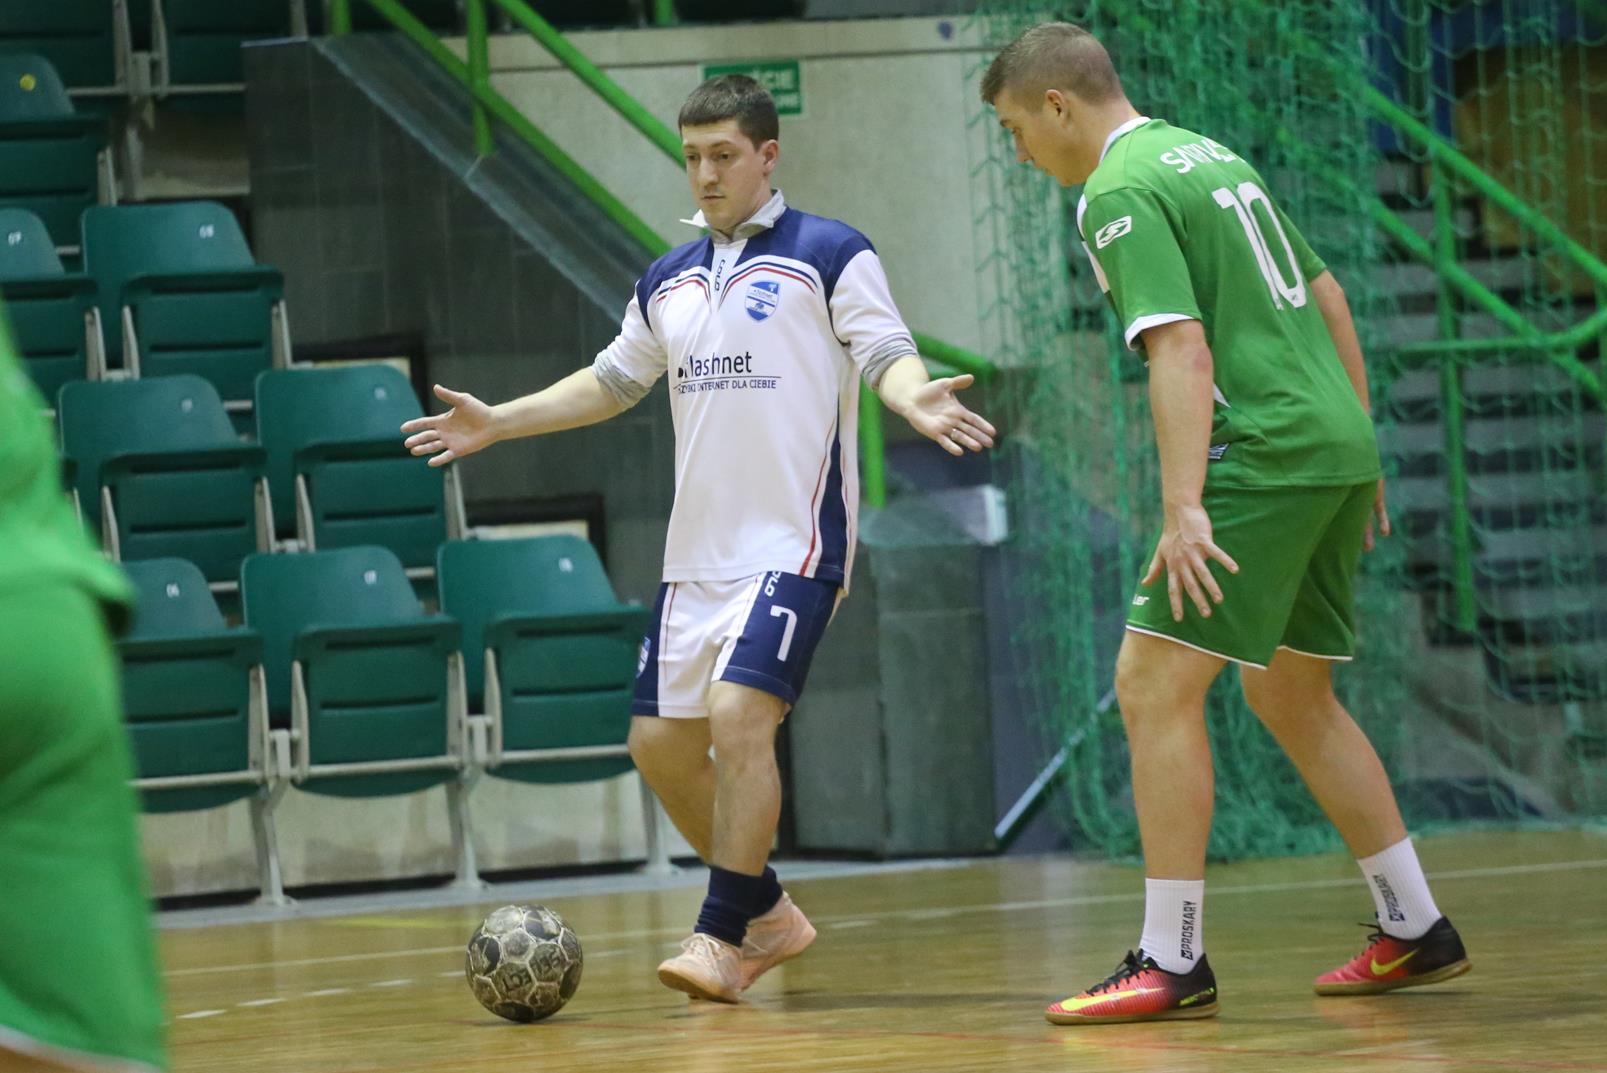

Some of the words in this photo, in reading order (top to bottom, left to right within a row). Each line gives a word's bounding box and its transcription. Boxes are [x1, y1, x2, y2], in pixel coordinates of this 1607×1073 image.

[1211, 181, 1307, 311] 10
[684, 352, 752, 378] lashnet
[731, 380, 748, 390] DLA
[749, 379, 777, 390] CIEBIE
[769, 604, 798, 662] 7
[1181, 900, 1198, 951] PROSKARY
